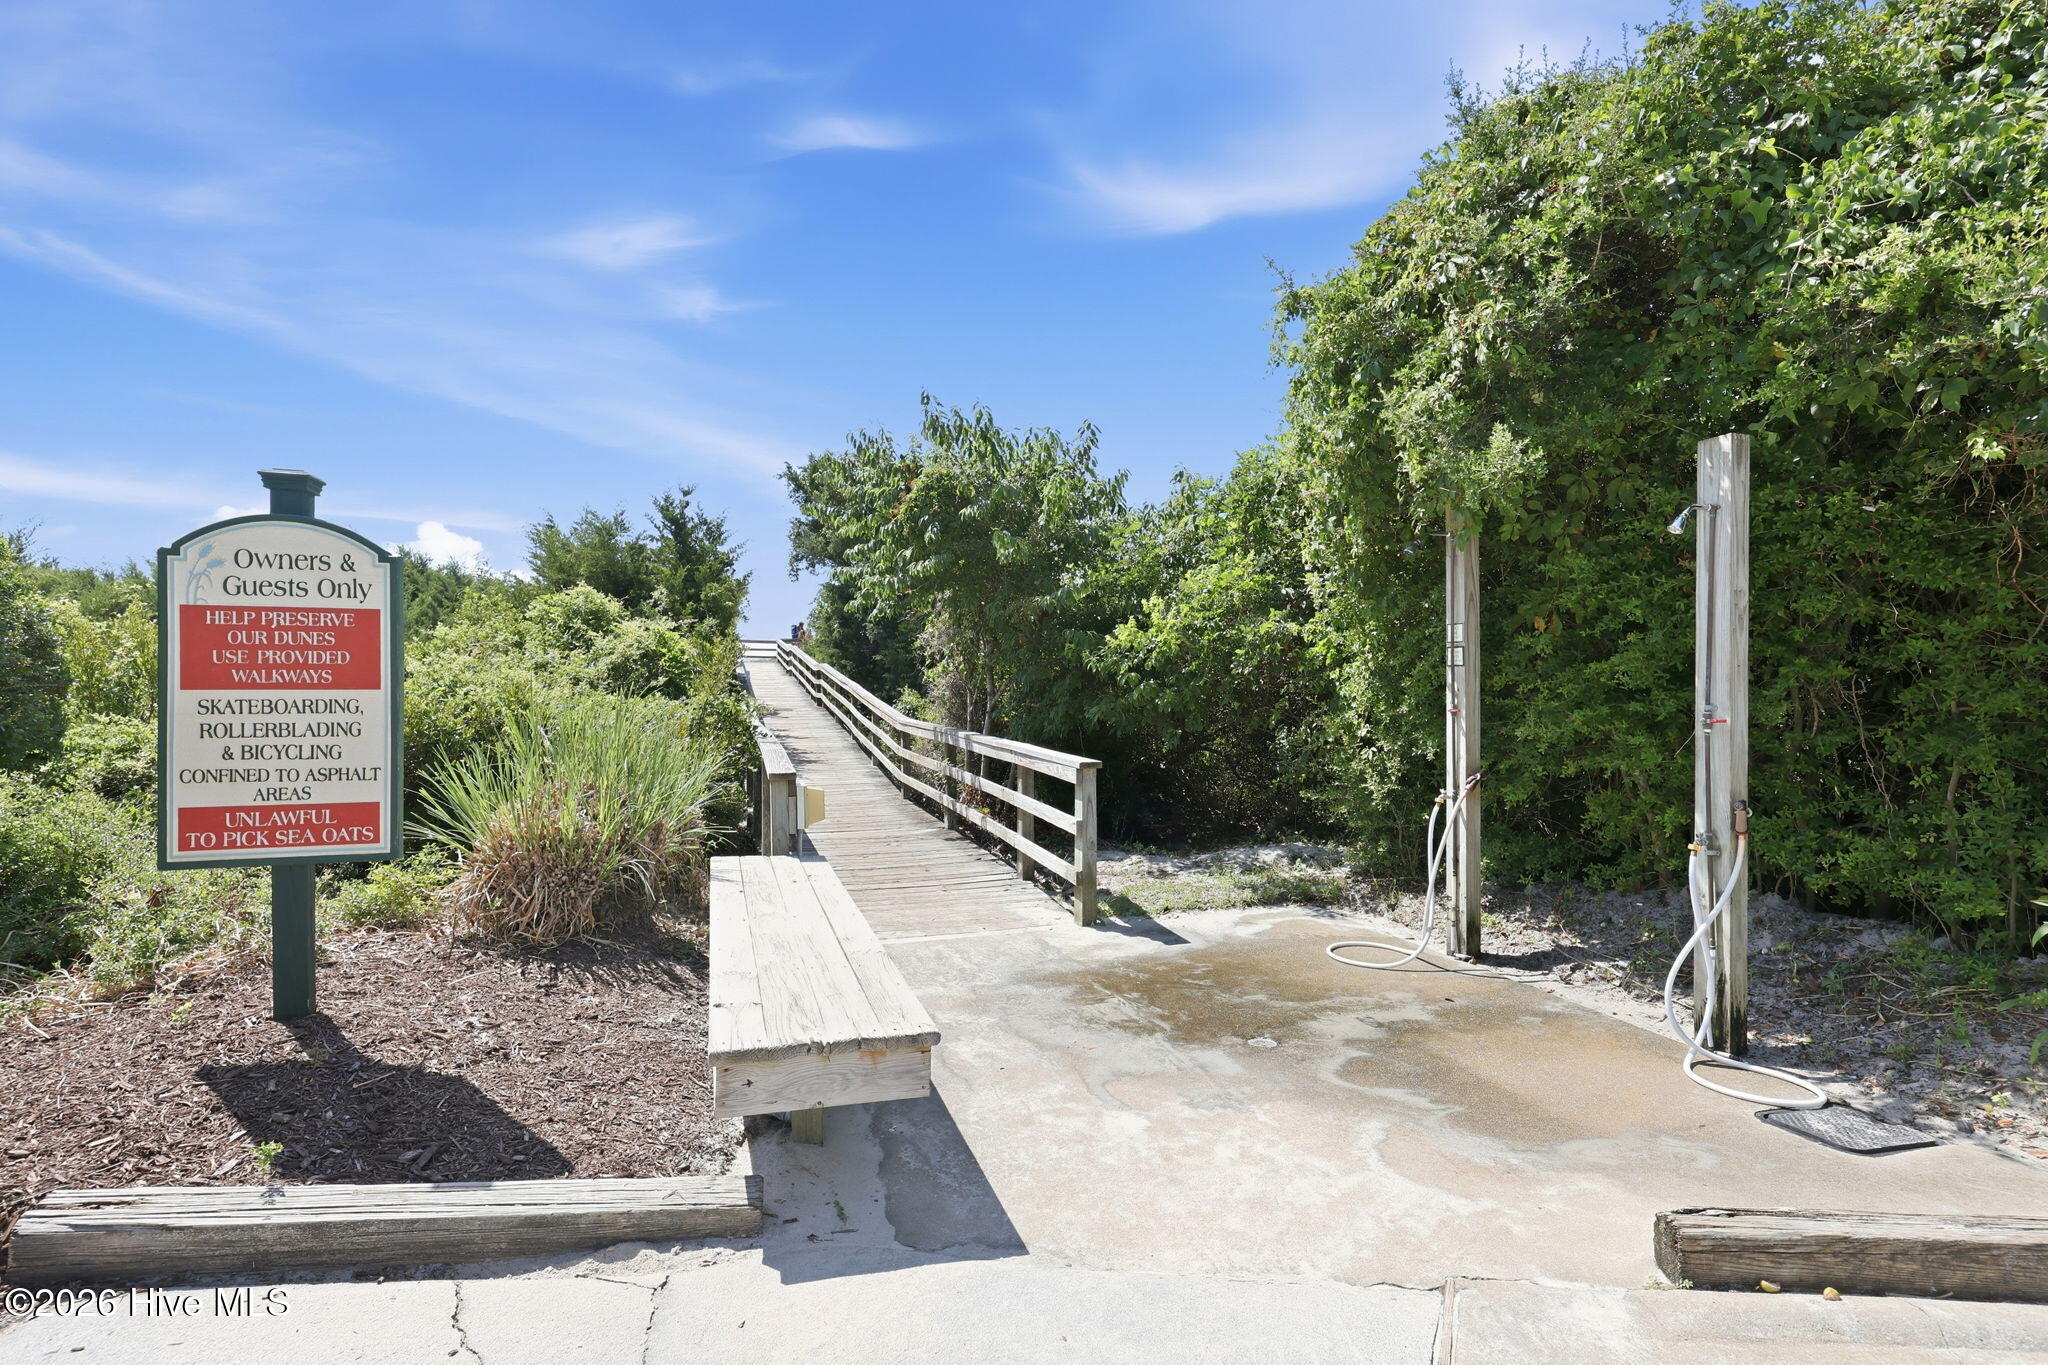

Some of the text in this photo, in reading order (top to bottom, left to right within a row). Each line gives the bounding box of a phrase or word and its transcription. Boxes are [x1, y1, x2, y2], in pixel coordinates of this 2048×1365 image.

[234, 549, 356, 572] Owners &
[222, 575, 372, 603] Guests Only
[206, 611, 355, 628] HELP PRESERVE
[227, 631, 335, 645] OUR DUNES
[212, 650, 350, 664] USE PROVIDED
[231, 670, 332, 683] WALKWAYS
[197, 699, 364, 715] SKATEBOARDING,
[200, 722, 361, 738] ROLLERBLADING
[222, 745, 342, 760] & BICYCLING
[179, 768, 381, 783] CONFINED TO ASPHALT
[253, 786, 311, 801] AREAS
[225, 810, 337, 827] UNLAWFUL
[186, 827, 374, 848] TO PICK SEA OATS
